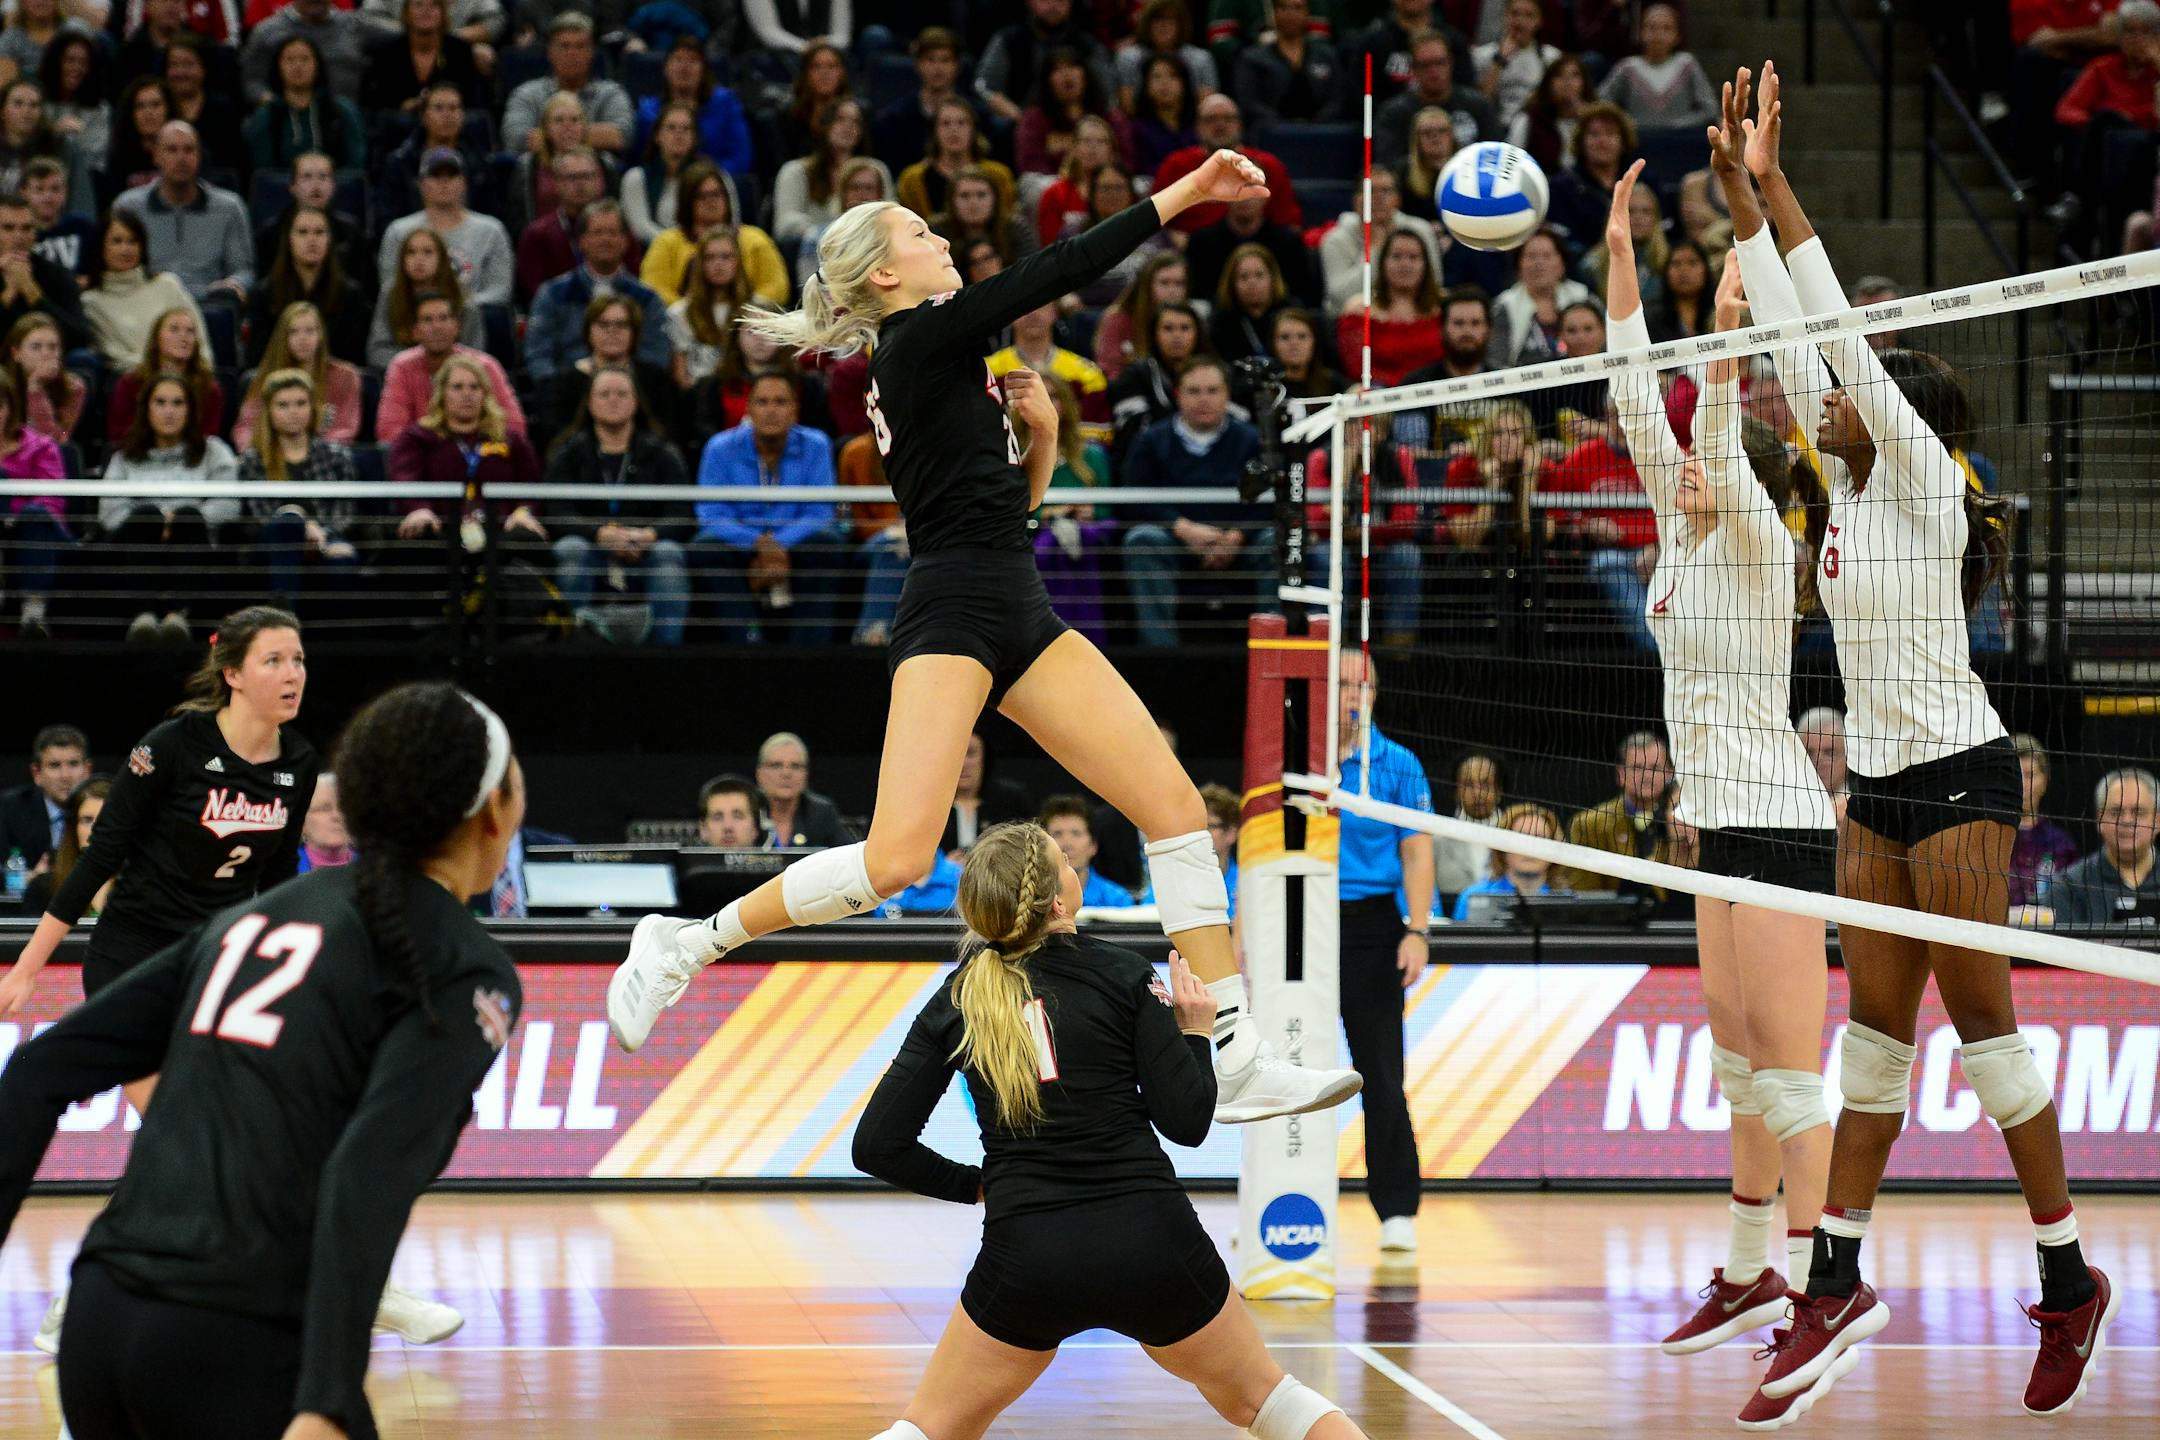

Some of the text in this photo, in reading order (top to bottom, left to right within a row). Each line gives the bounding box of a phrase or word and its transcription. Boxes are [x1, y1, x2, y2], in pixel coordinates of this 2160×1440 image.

[213, 844, 252, 879] 2
[188, 912, 325, 1050] 12
[1022, 997, 1060, 1084] 1
[1264, 1224, 1326, 1247] NCAA
